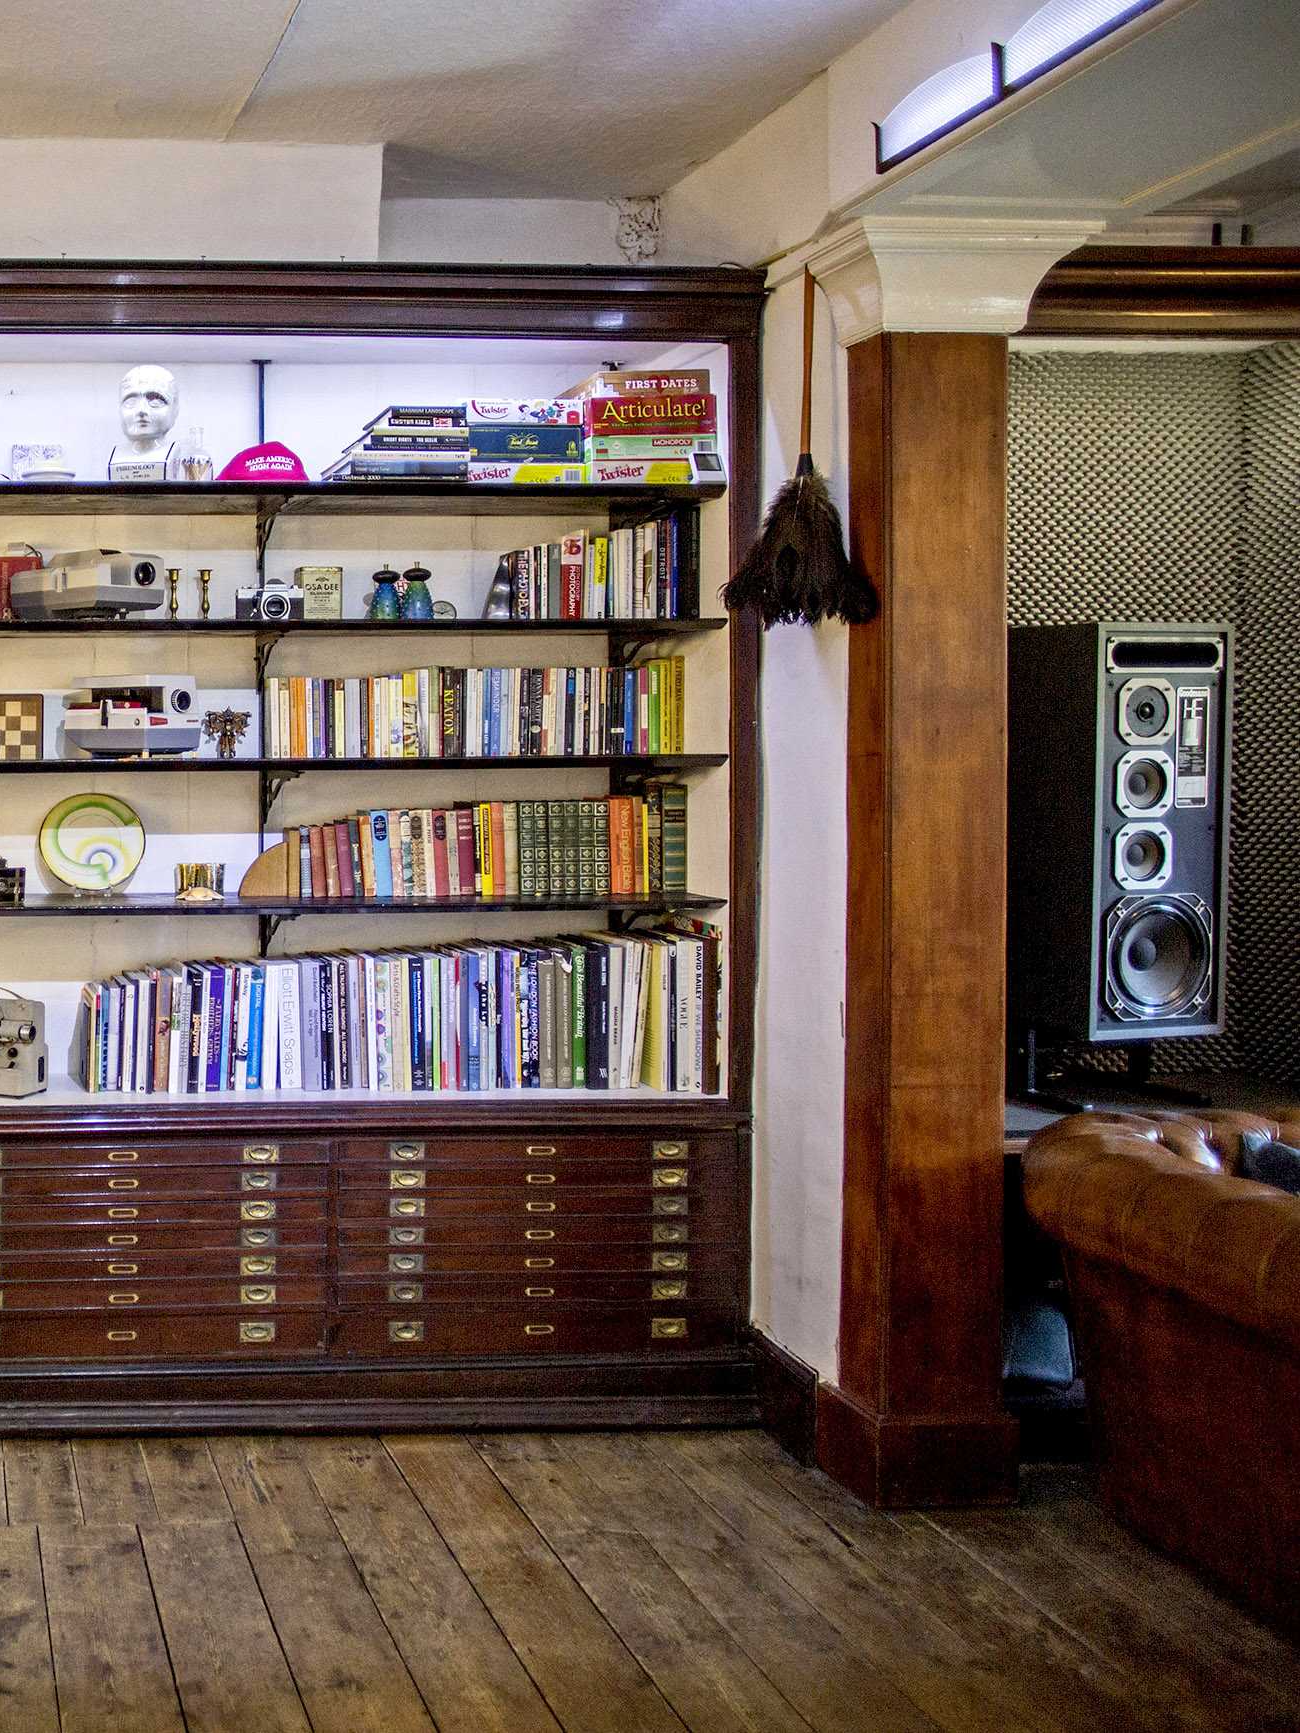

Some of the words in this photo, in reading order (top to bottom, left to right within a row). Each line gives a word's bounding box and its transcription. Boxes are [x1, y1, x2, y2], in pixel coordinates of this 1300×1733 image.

[625, 379, 657, 389] FIRST
[660, 378, 697, 389] DATES
[480, 406, 508, 414] Twister
[601, 398, 706, 423] Articulate!
[245, 456, 265, 466] MAKE
[266, 456, 295, 465] AMERICA
[250, 463, 270, 472] HIGH
[271, 463, 293, 471] AGAIN
[597, 465, 644, 482] Twister
[568, 566, 576, 616] PHOTOGRAPHY
[493, 672, 501, 713] REMAINDER
[674, 670, 683, 702] PERELMAN
[444, 689, 454, 735] KEATON
[620, 806, 630, 828] New
[620, 829, 631, 865] English
[622, 865, 632, 890] Bible
[576, 954, 586, 973] This
[695, 946, 703, 971] DAVID
[241, 974, 249, 996] Banksy
[281, 968, 294, 999] Elliott
[576, 974, 586, 1007] Beautiful
[180, 993, 191, 1026] BEFORE
[282, 1001, 295, 1035] Erwitt
[326, 1010, 334, 1033] LOREN
[393, 1002, 401, 1018] Style
[679, 997, 689, 1030] VOGUE
[695, 1014, 702, 1027] WE
[192, 1014, 201, 1057] Hollywood
[575, 1009, 586, 1039] Britain
[179, 1031, 190, 1069] HISTORY
[282, 1039, 296, 1075] Snaps
